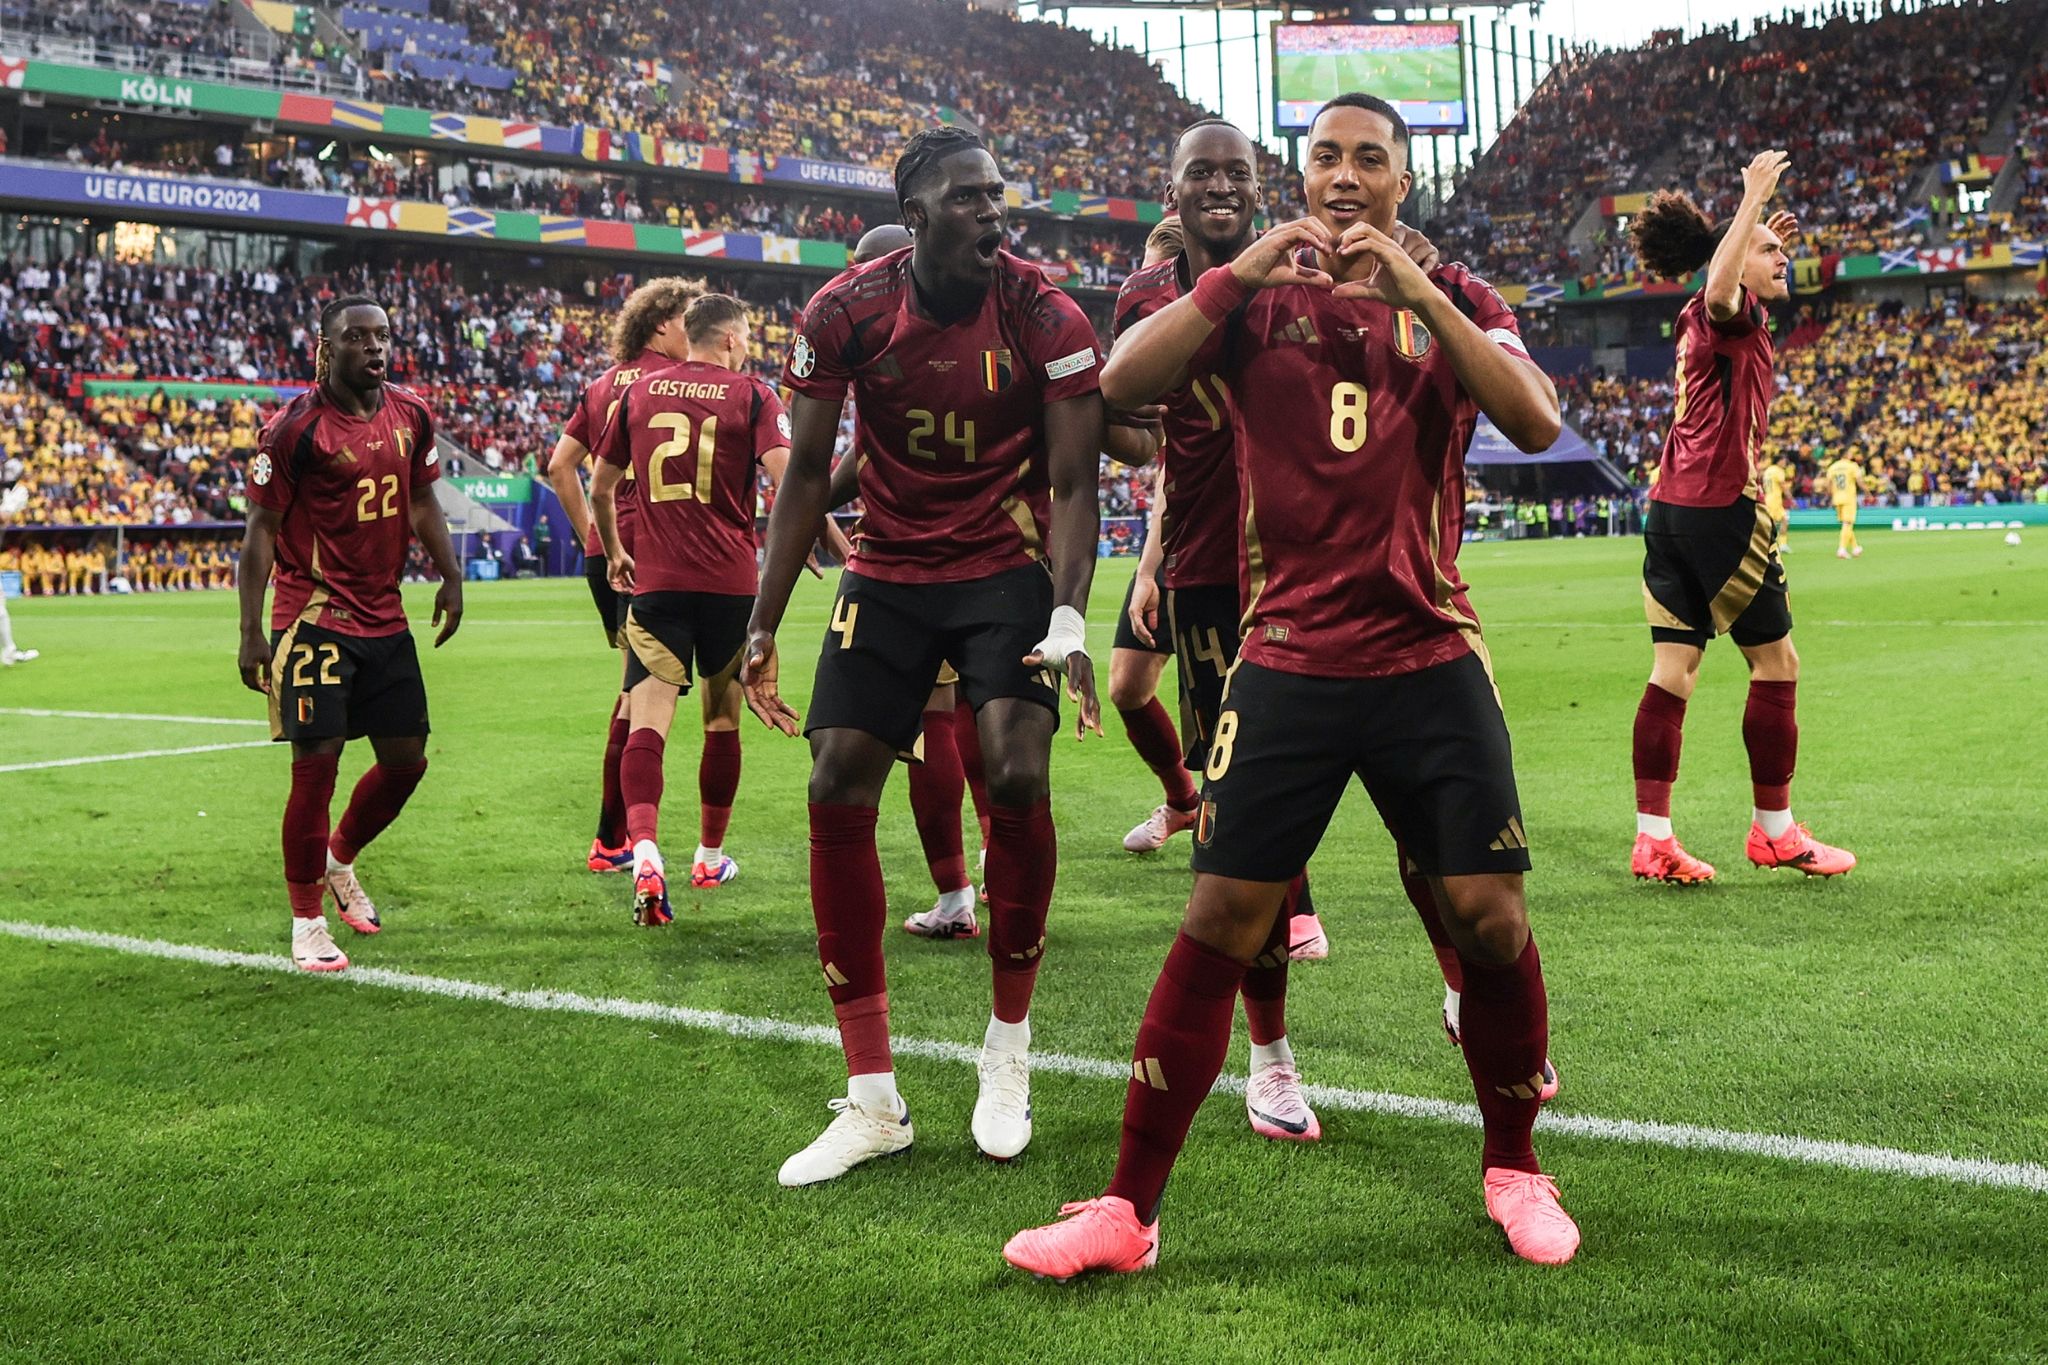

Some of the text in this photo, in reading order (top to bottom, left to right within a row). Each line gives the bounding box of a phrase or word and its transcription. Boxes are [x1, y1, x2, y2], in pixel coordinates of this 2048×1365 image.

[121, 76, 193, 107] KÖLN
[648, 379, 730, 401] CASTAGNE
[1330, 381, 1368, 453] 8
[647, 412, 718, 504] 21
[905, 408, 976, 462] 24
[356, 473, 399, 522] 22
[464, 480, 509, 498] KÖLN
[830, 594, 859, 649] 4
[292, 642, 342, 687] 22
[1179, 624, 1228, 690] 14
[1206, 710, 1239, 782] 8
